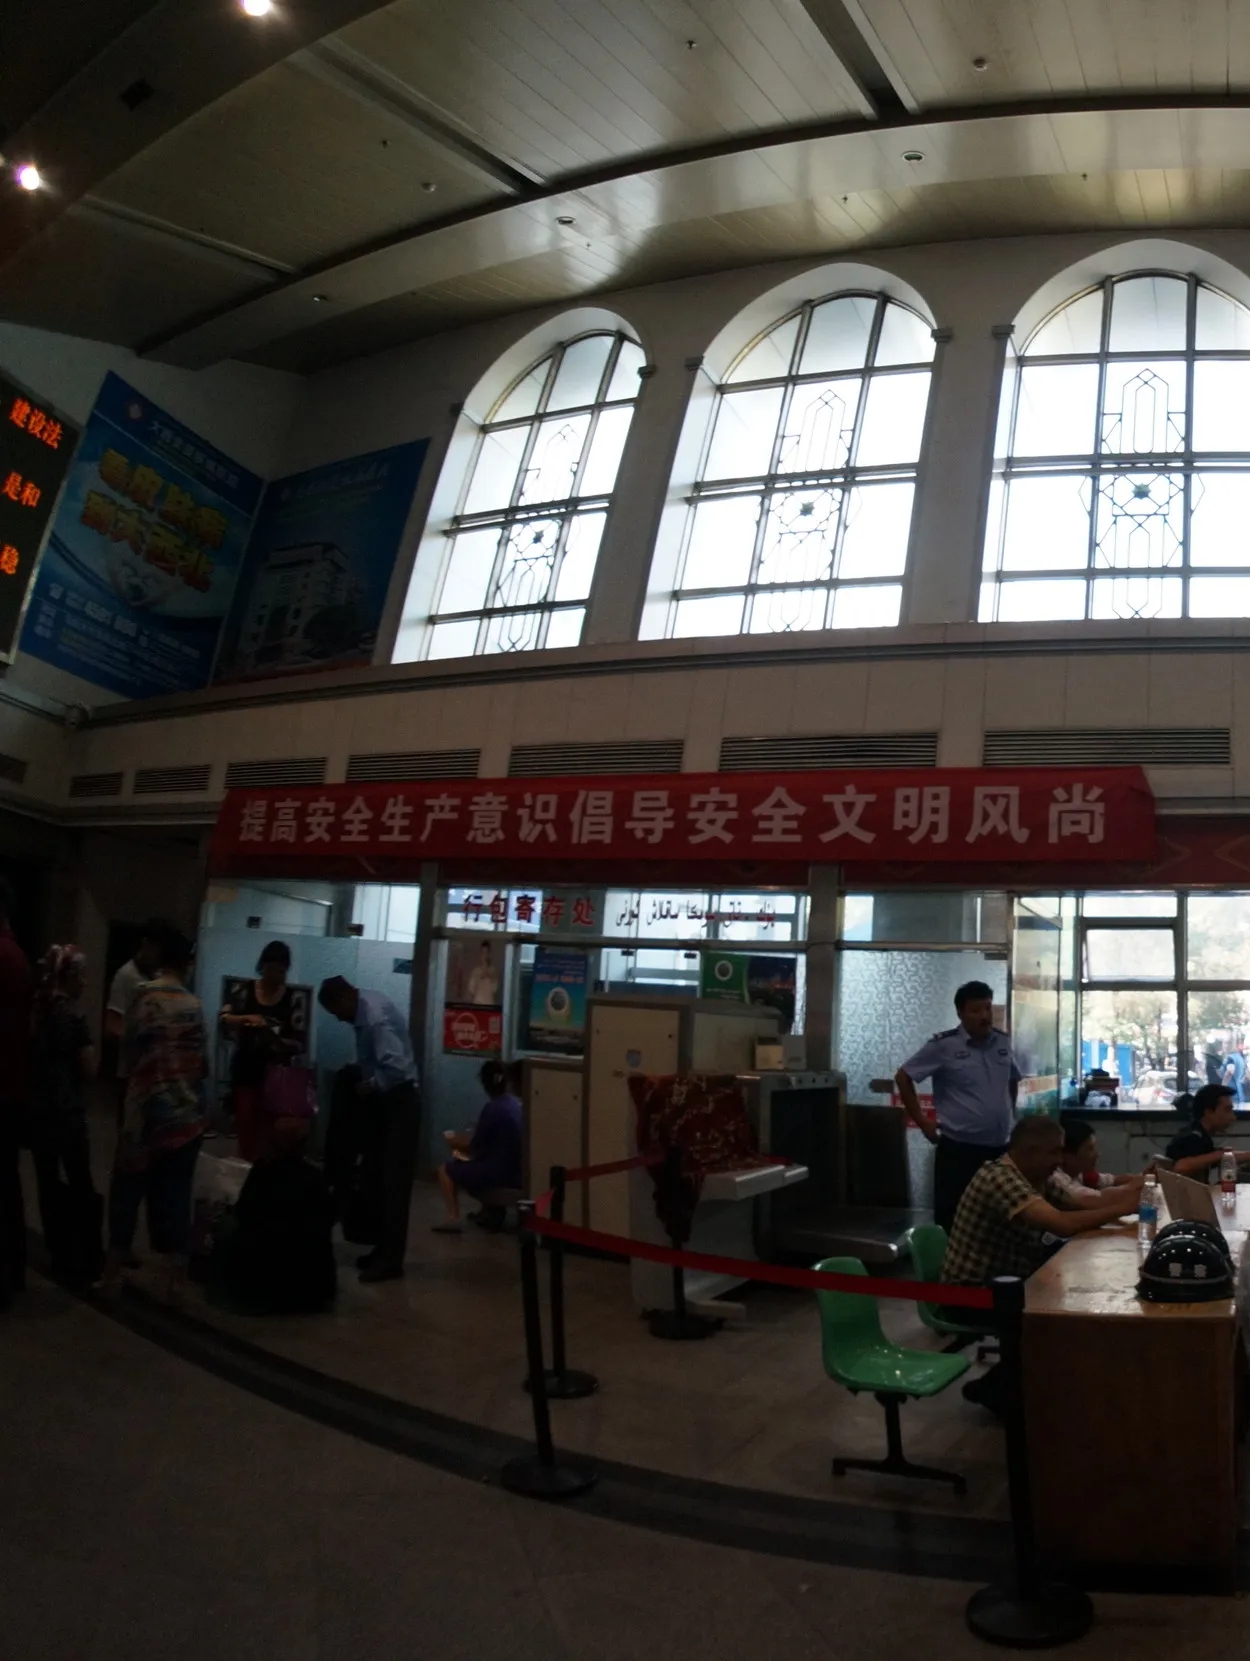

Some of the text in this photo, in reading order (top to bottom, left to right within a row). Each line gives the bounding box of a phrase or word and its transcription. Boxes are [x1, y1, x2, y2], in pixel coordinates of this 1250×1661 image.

[237, 782, 1107, 845] 提高安全生产意识倡导安全文明风尚
[463, 893, 597, 927] 行包寄存处
